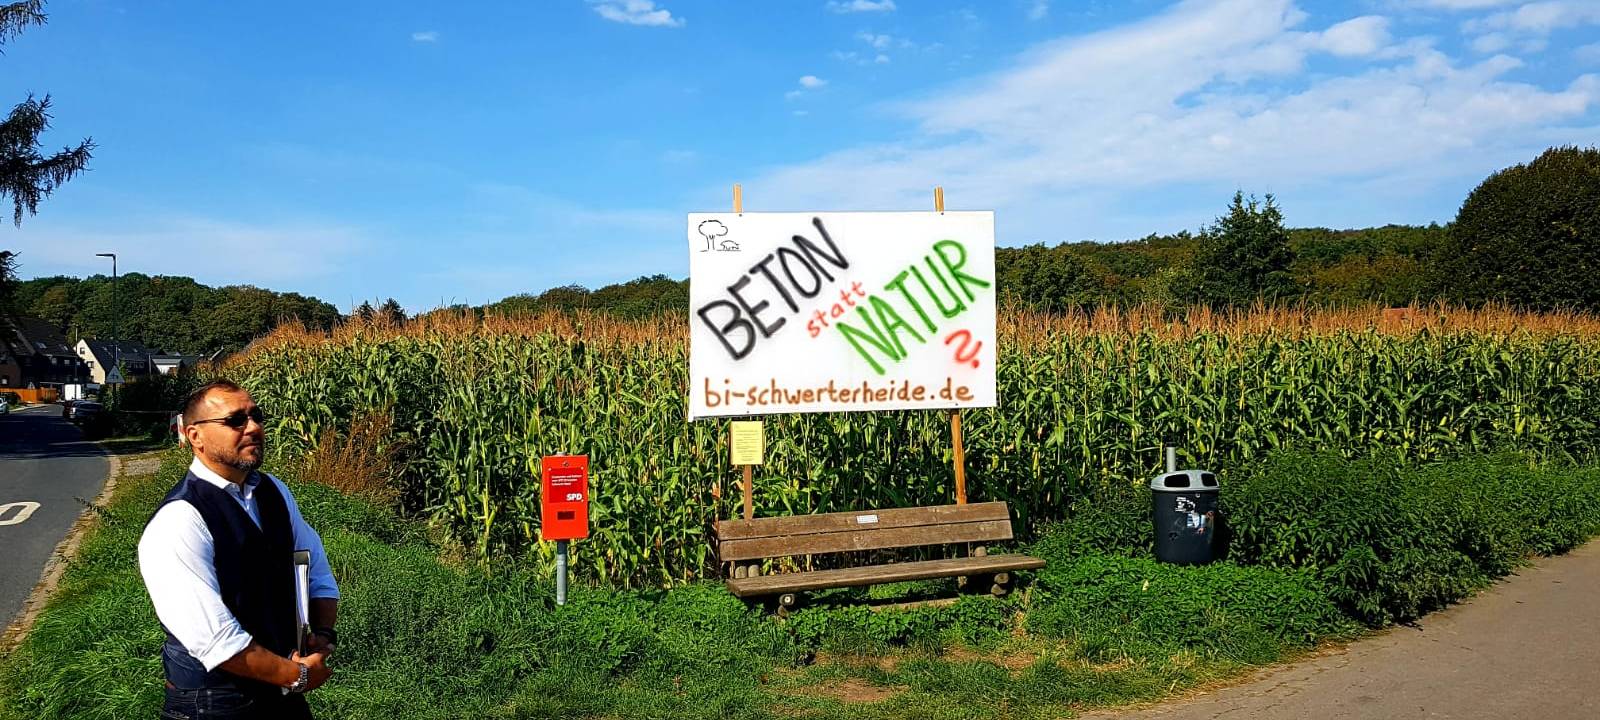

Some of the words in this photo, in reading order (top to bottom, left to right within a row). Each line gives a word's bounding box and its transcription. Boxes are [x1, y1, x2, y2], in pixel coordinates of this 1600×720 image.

[697, 217, 849, 360] BETON
[805, 281, 866, 338] statt
[836, 240, 990, 375] NATUR
[704, 377, 974, 407] bi-schwerterheide.de
[566, 493, 582, 501] SPD
